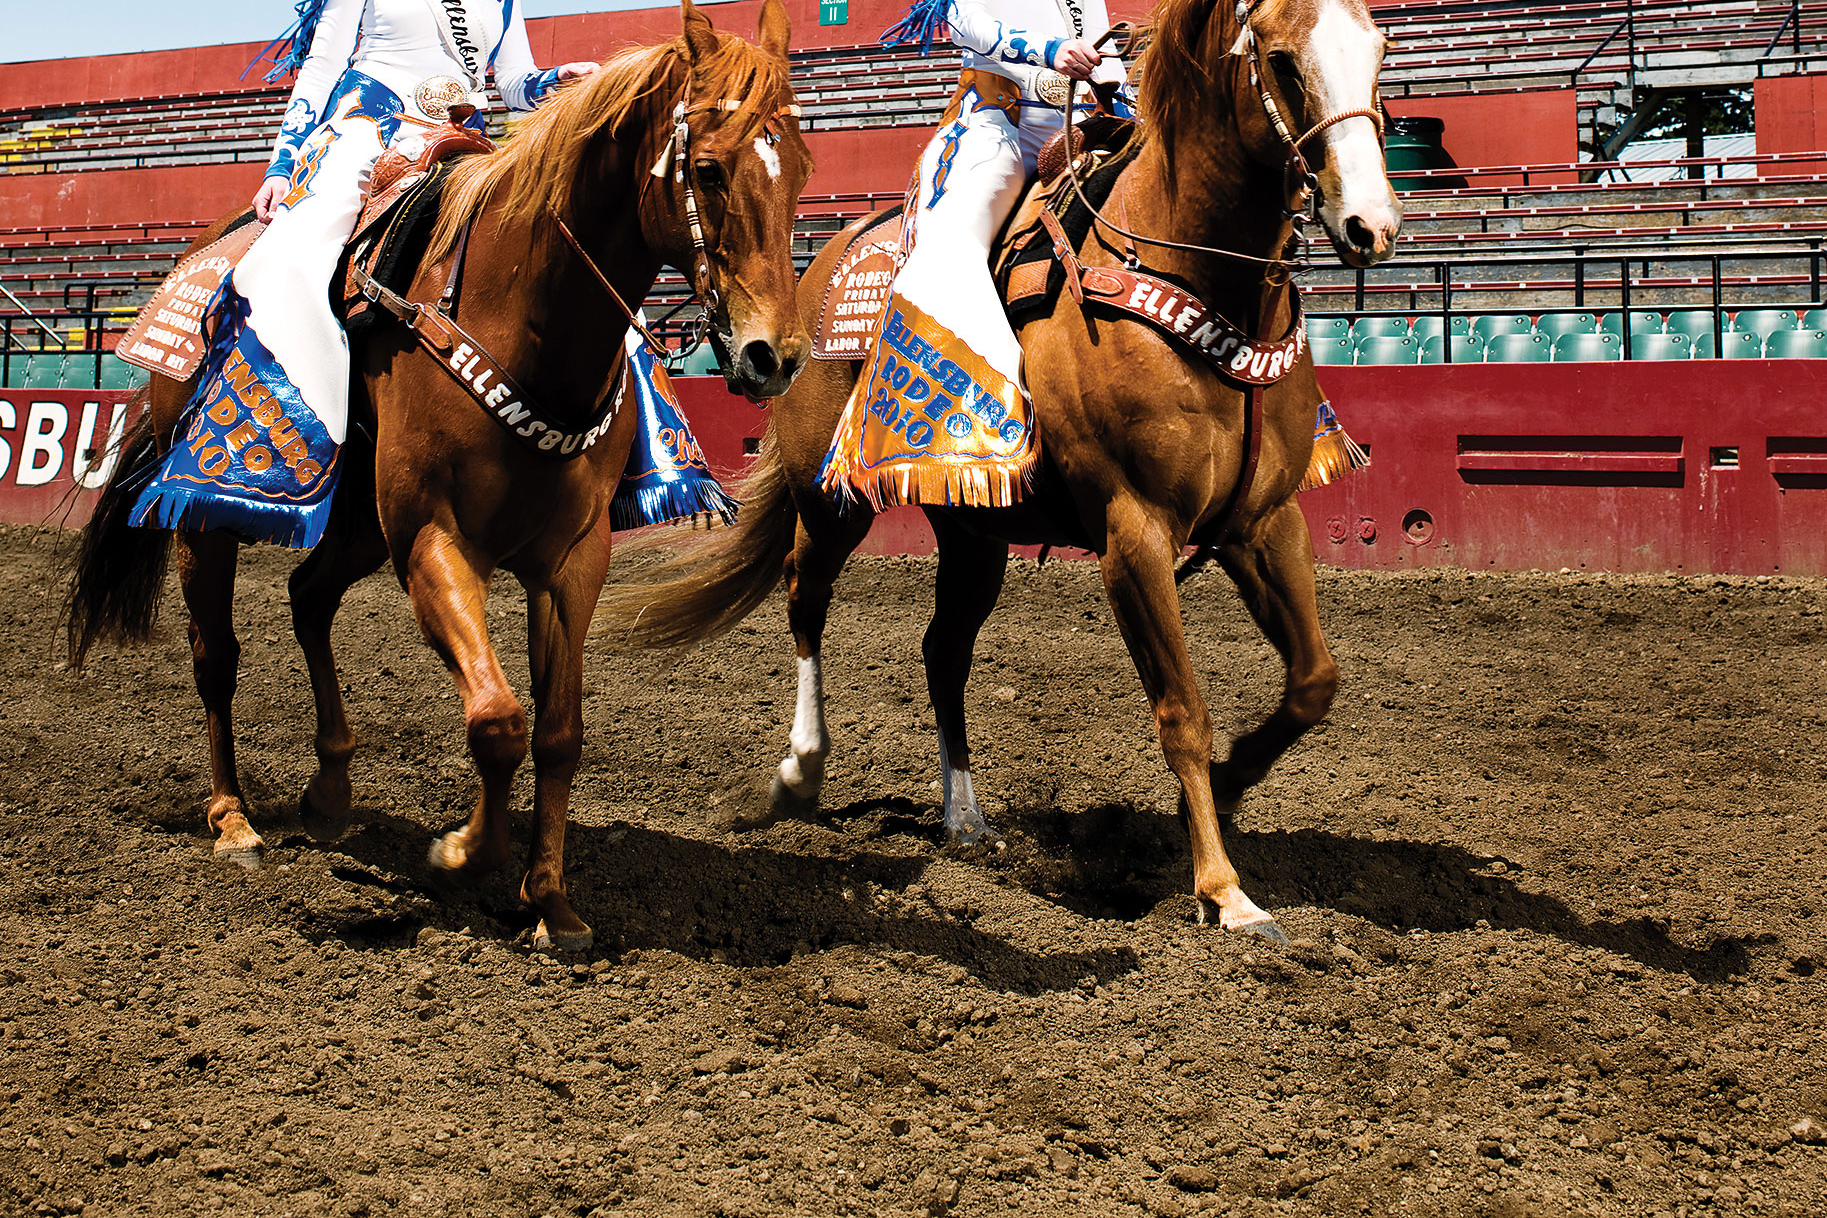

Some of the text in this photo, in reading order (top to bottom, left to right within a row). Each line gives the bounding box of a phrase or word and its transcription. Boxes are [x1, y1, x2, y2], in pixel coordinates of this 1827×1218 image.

[843, 287, 887, 301] FRIDAY
[1126, 282, 1295, 378] ELLENSBURG
[824, 337, 860, 352] LABOR
[449, 342, 612, 445] ELLENSBURG
[869, 387, 934, 450] 2010
[879, 354, 973, 438] RODEO
